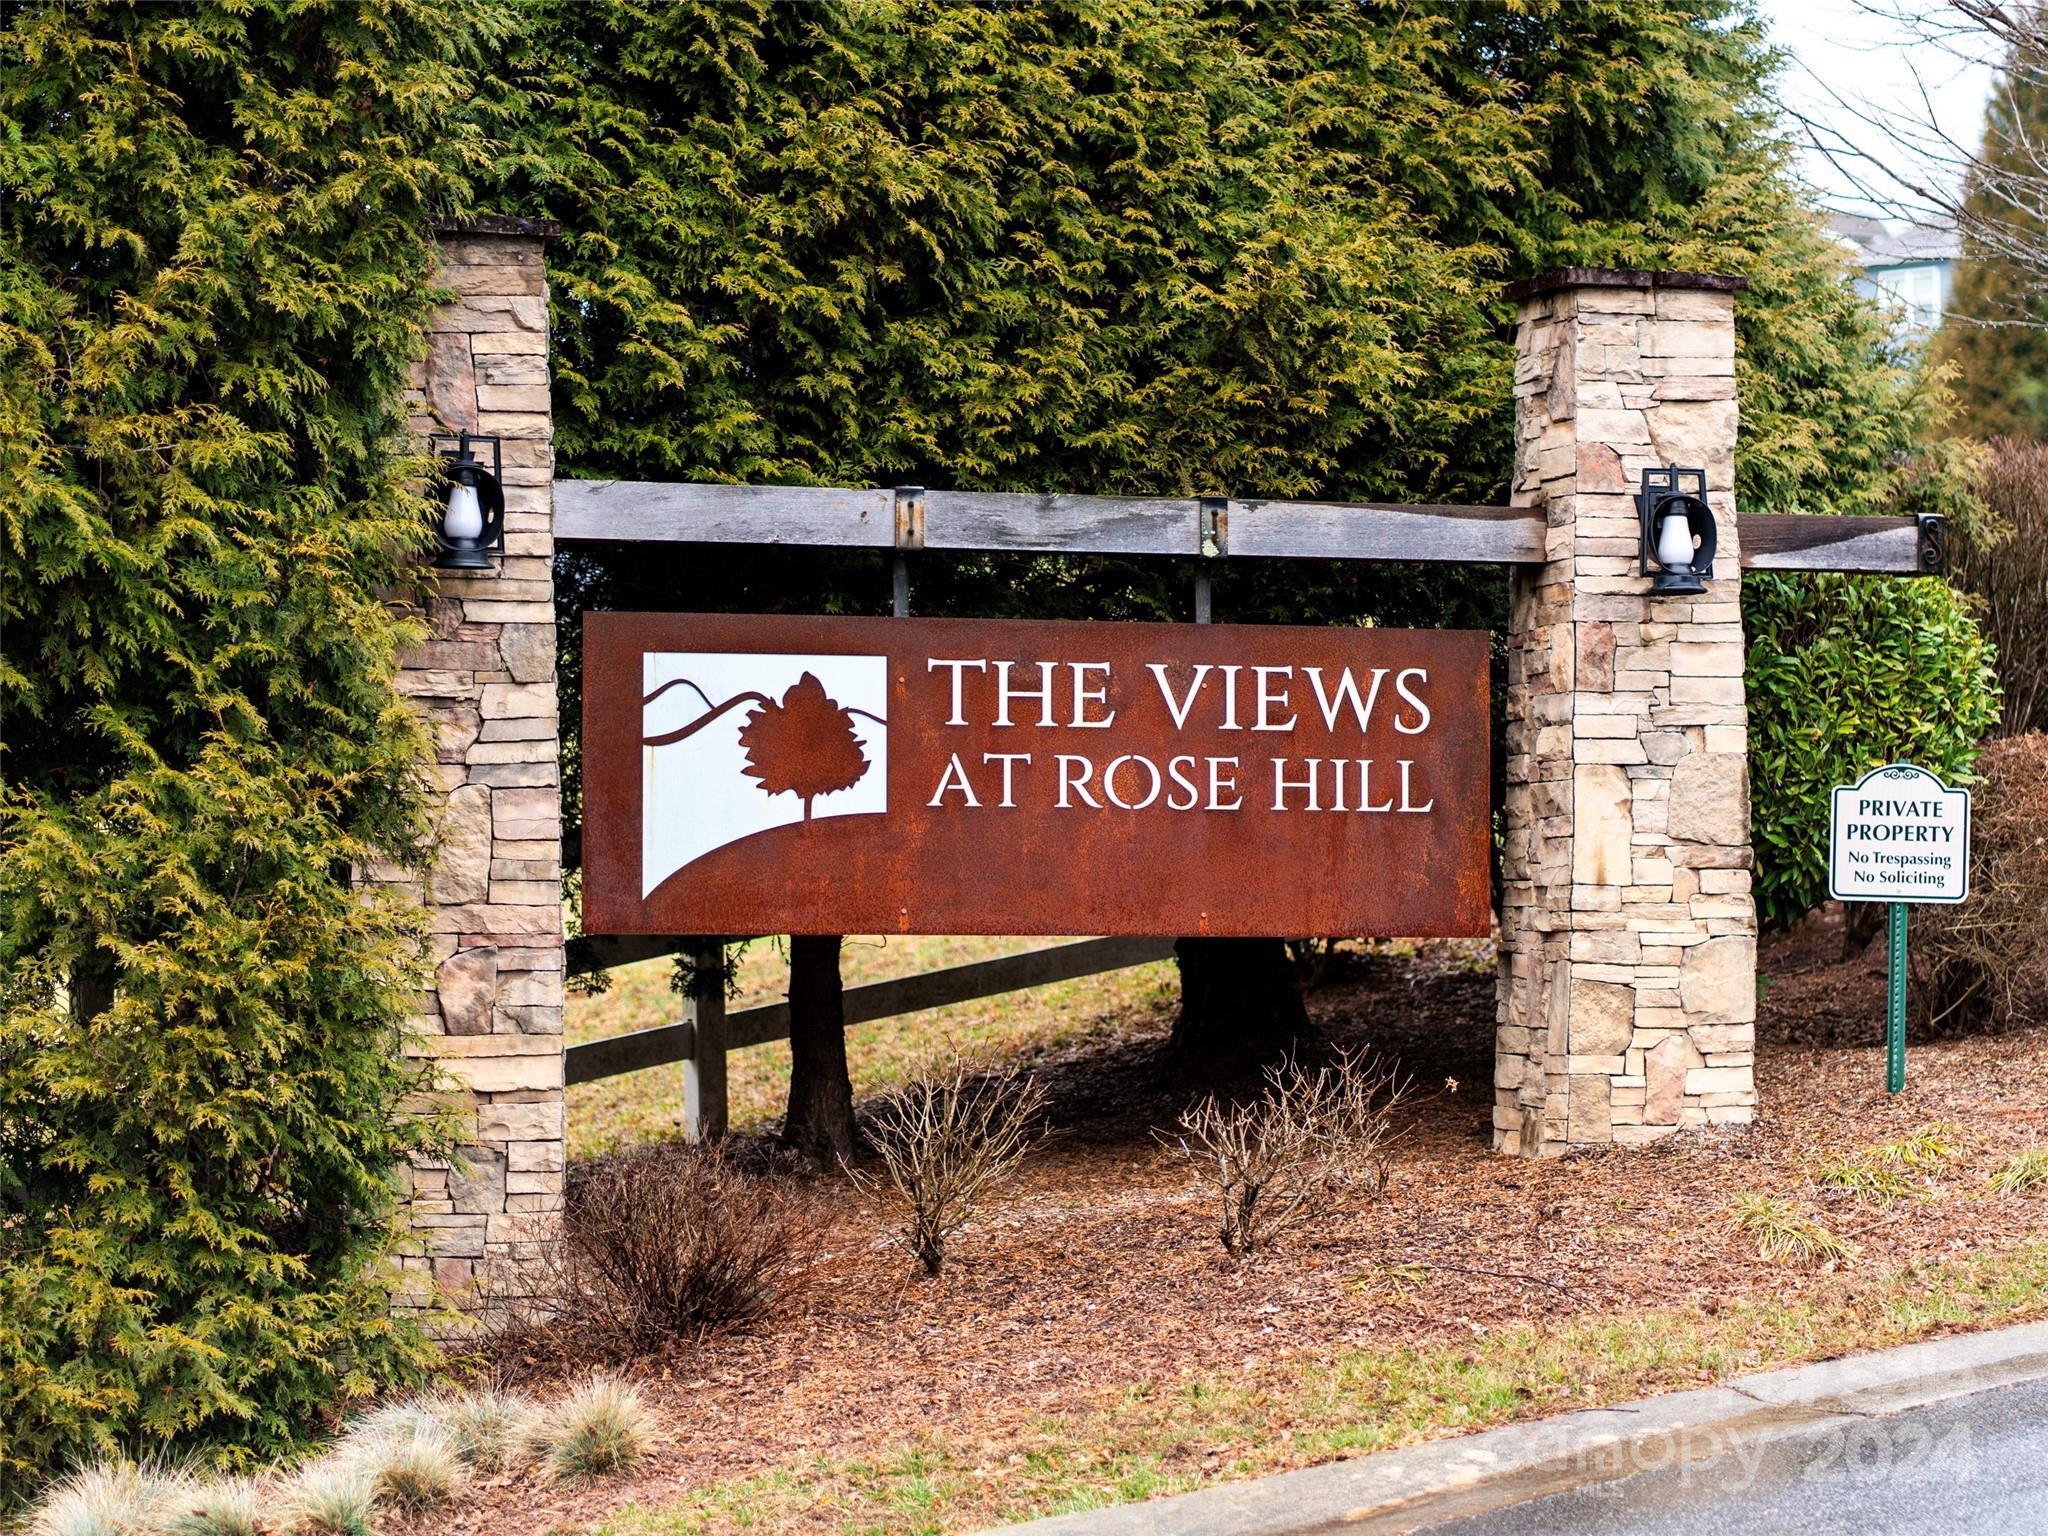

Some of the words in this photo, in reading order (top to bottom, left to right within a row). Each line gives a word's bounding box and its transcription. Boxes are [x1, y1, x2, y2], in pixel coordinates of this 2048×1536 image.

[927, 657, 1115, 727] THE
[1145, 663, 1430, 734] VIEWS
[926, 752, 1031, 806] AT
[1053, 754, 1242, 810] ROSE
[1270, 758, 1433, 812] HILL
[1859, 799, 1942, 817] PRIVATE
[1847, 823, 1953, 842] PROPERTY
[1848, 851, 1869, 863] No
[1872, 851, 1951, 868] Trespassing
[1854, 870, 1874, 882] No
[1879, 870, 1944, 887] Soliciting
